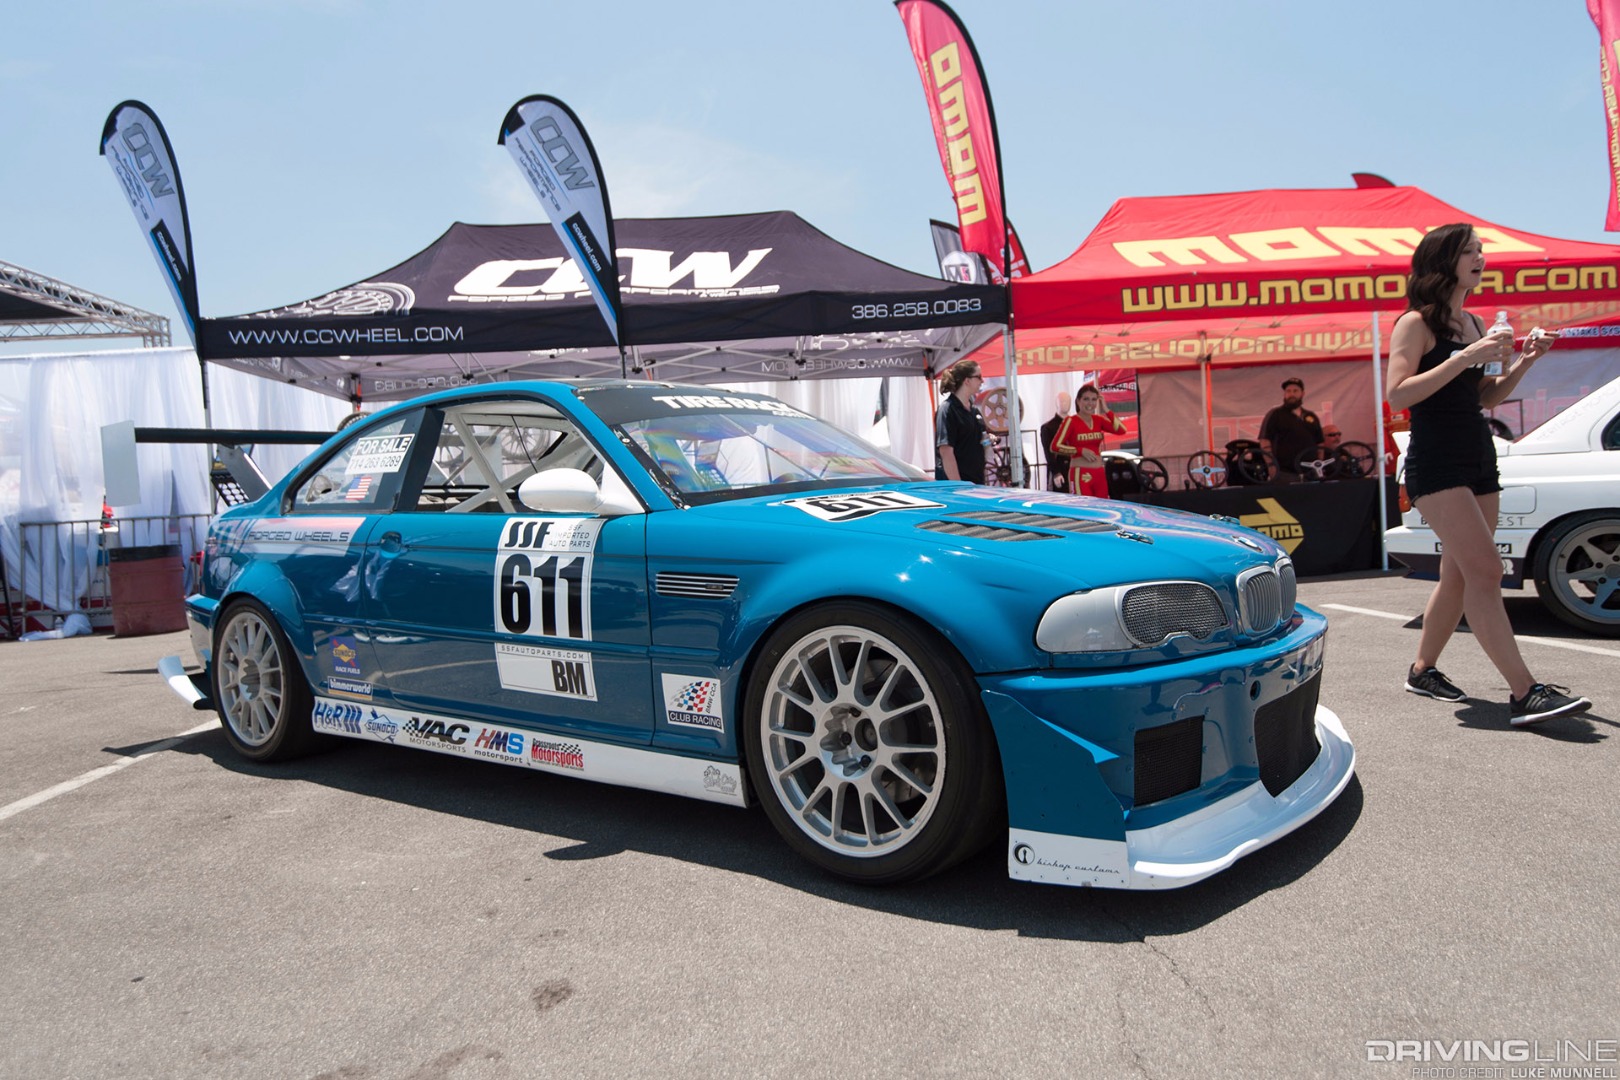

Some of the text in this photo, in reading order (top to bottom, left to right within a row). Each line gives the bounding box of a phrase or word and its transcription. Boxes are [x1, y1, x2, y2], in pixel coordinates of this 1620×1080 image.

[122, 122, 175, 199] CCW
[530, 116, 596, 191] CCW
[529, 150, 556, 191] FORCED
[156, 231, 182, 282] ccwheel.com
[572, 222, 602, 272] ccwheel.com
[574, 285, 781, 299] PRFORMANCE
[851, 297, 981, 319] 386.258.0083
[228, 326, 464, 345] WWW.CCWHEEL.COM
[354, 436, 411, 455] FOR SALE
[248, 531, 350, 542] FORCED WHEELS
[504, 521, 554, 548] SSF
[570, 540, 591, 548] PARTS
[500, 553, 586, 639] 611
[501, 644, 584, 660] SSFAUTOPARTS.COM
[347, 667, 360, 675] FUELS
[551, 660, 588, 696] BM
[329, 678, 371, 695] bimmerworld
[313, 702, 345, 729] H&R
[705, 697, 713, 714] BMW
[367, 721, 396, 734] SUNOCO
[669, 711, 721, 727] CLUB RACING
[408, 717, 470, 746] VAC
[474, 728, 525, 755] HMS
[409, 737, 467, 754] MOTORSPORTS
[474, 749, 523, 764] motorsport
[531, 745, 584, 768] Motorsports
